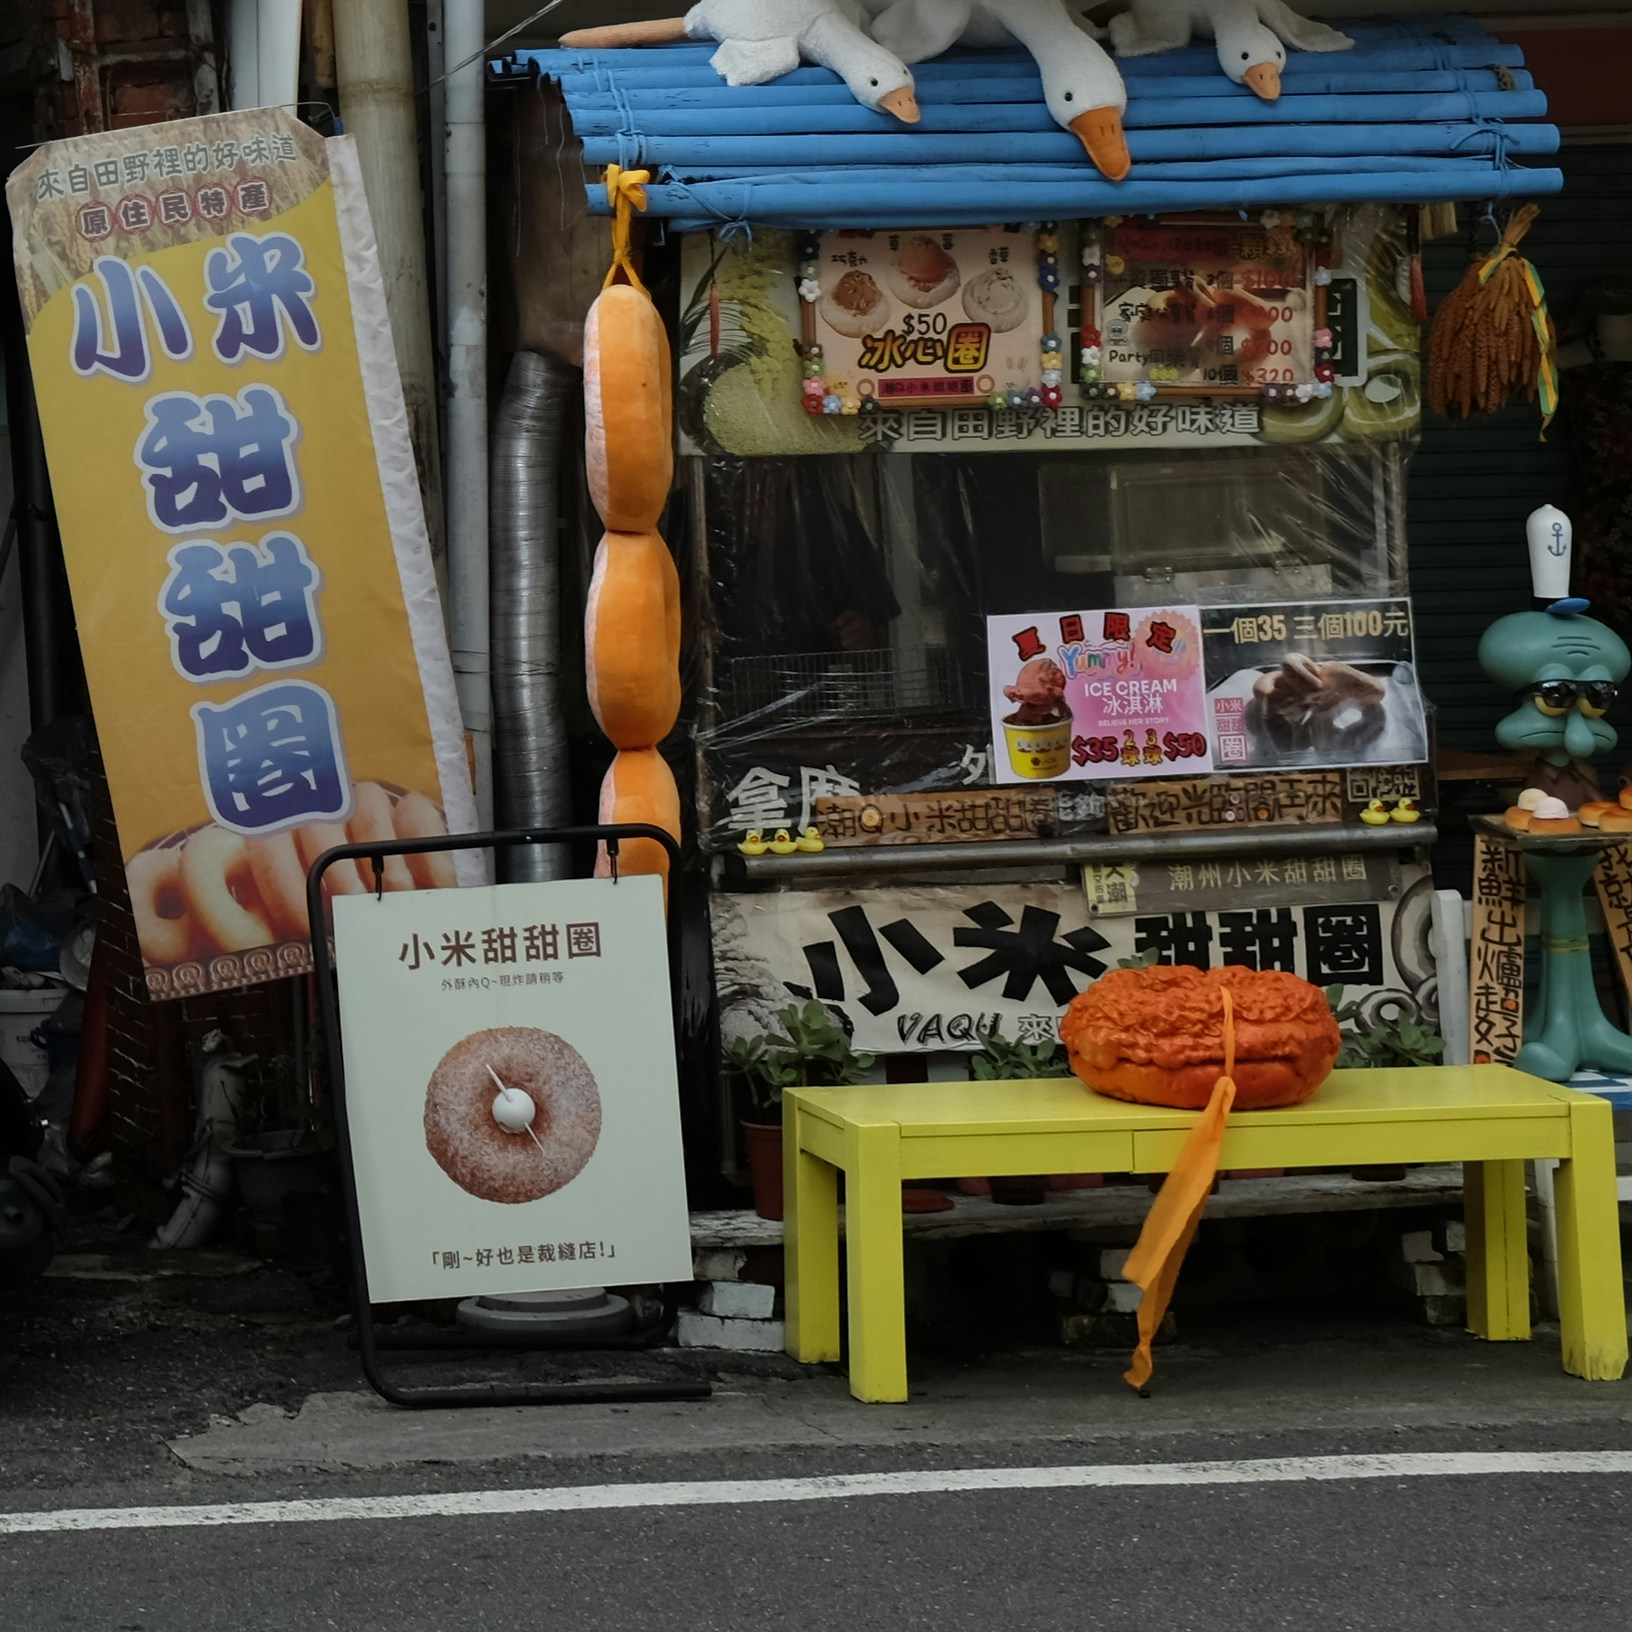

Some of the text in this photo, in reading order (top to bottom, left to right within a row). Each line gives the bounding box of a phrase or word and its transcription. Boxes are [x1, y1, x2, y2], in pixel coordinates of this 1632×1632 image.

[37, 133, 297, 202] 來自田野裡的好味道
[80, 179, 270, 237] 原住民特產
[71, 232, 322, 382] 小米
[902, 312, 947, 337] $50
[858, 322, 991, 373] 冰心圈
[859, 401, 1261, 442] 來自田野裡的好味道
[1012, 611, 1177, 662] 夏日限定
[1203, 609, 1409, 644] 一個35 三個100元
[1057, 641, 1137, 680] Yummy!
[1084, 679, 1178, 697] ICE CREAM
[1102, 693, 1163, 716] 冰淇淋
[1098, 716, 1170, 727] BELIEVE HER STORY
[1071, 733, 1119, 766] $35
[1164, 730, 1208, 765] $50
[1168, 854, 1368, 892] 潮州小米甜甜圈
[398, 922, 601, 971] 小米甜甜圈
